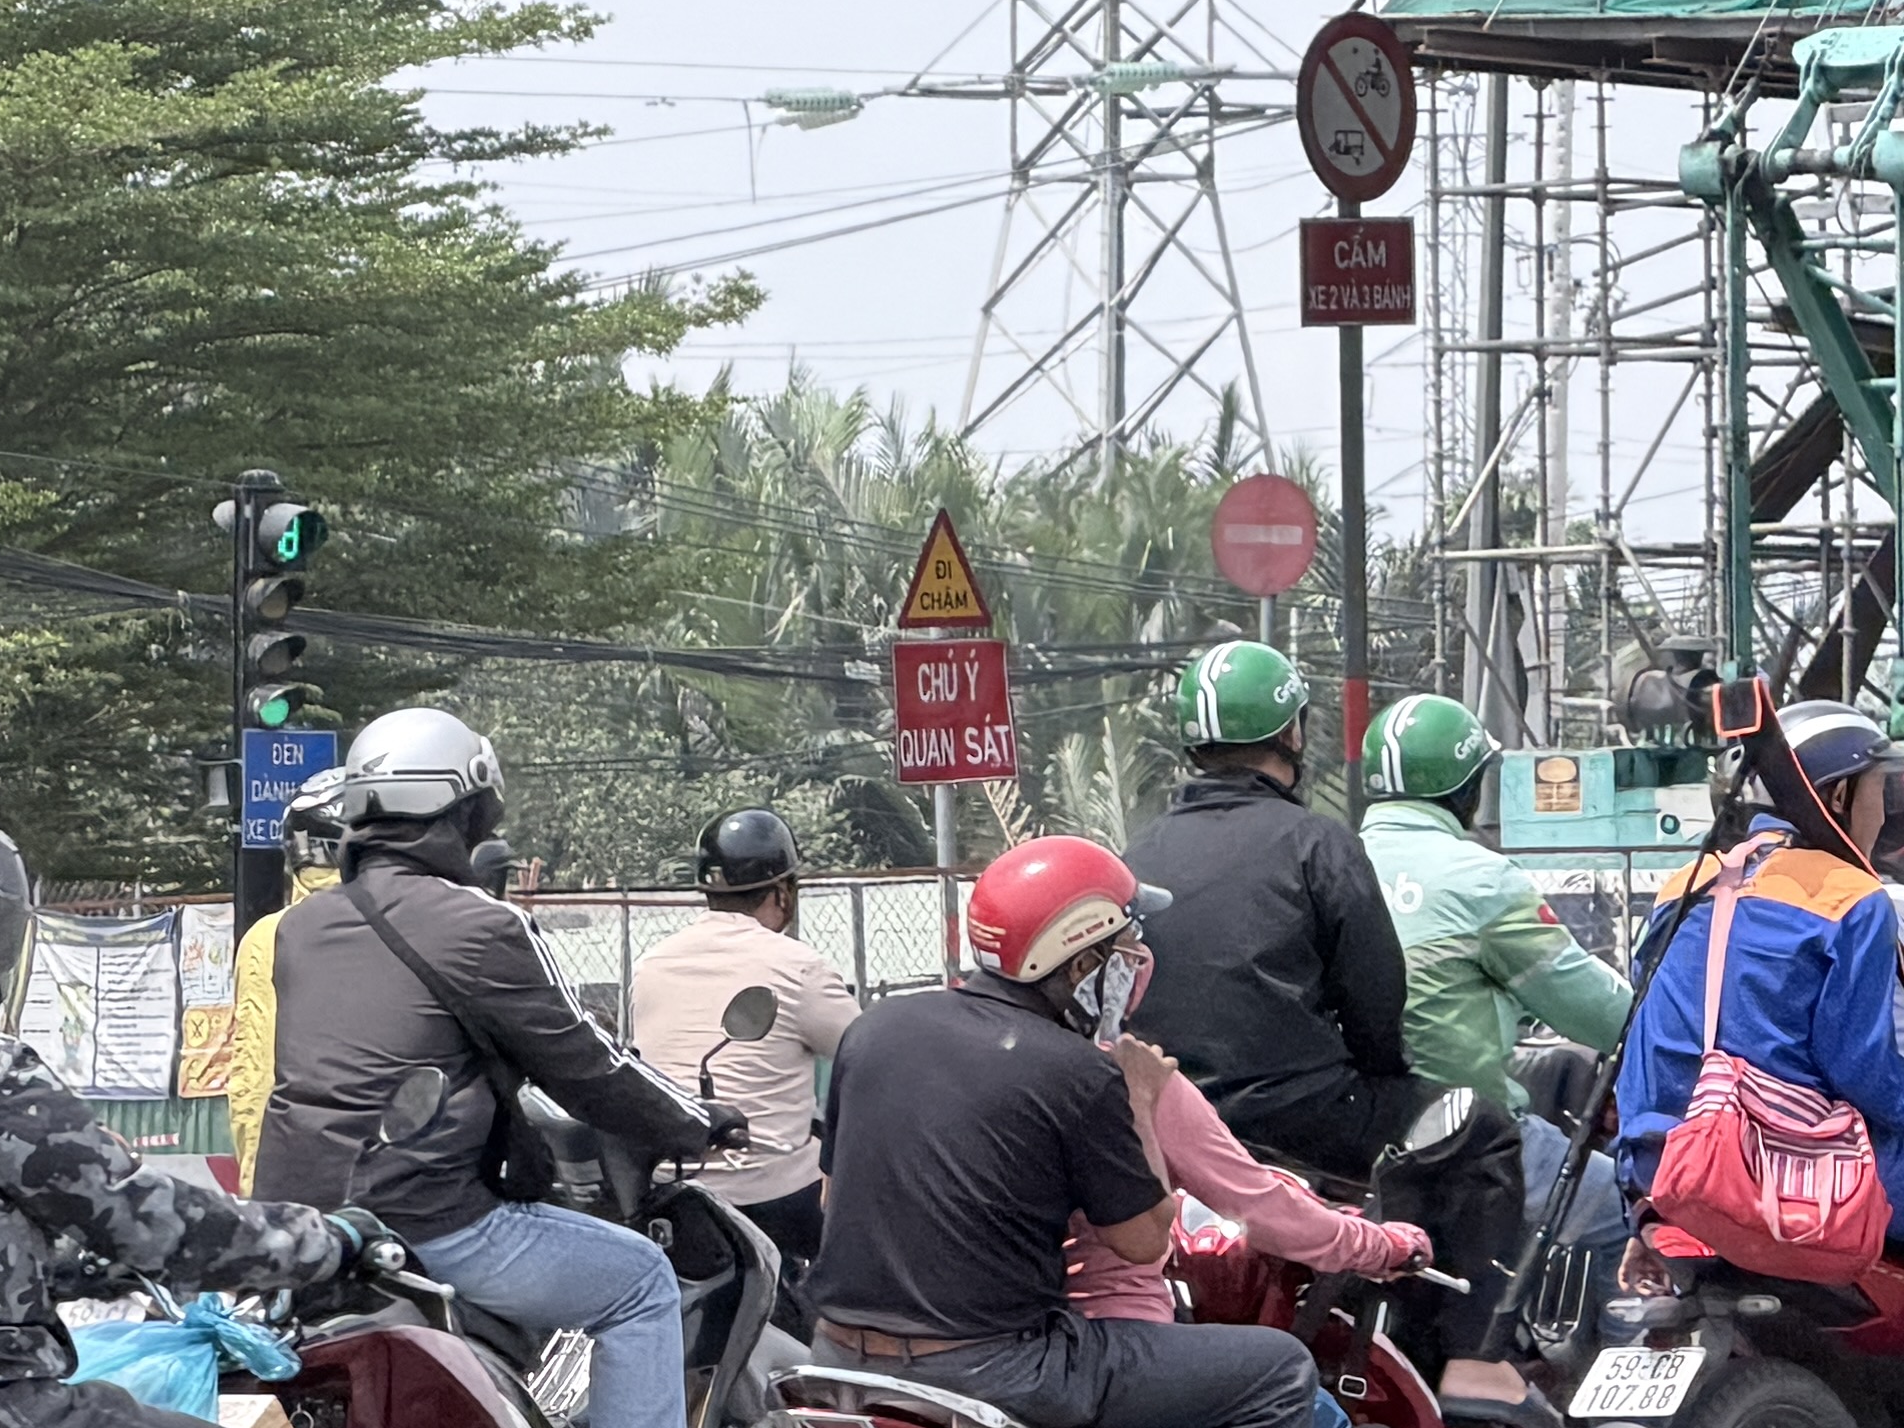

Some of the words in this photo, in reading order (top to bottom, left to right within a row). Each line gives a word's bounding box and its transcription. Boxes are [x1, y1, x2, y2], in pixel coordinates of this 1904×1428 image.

[1334, 225, 1386, 269] CẤM
[1309, 284, 1327, 310] XE
[1329, 284, 1338, 310] 2
[1340, 277, 1360, 309] VÀ
[1362, 284, 1370, 309] 3
[1373, 277, 1410, 310] BÁNH
[934, 559, 952, 580] ĐI
[920, 586, 968, 612] CHẬM
[917, 648, 958, 703] CHÚ
[965, 648, 979, 701] Ý
[900, 728, 956, 767] QUAN
[964, 713, 1010, 765] SÁT
[246, 818, 267, 841] XE
[1587, 1384, 1677, 1412] 107.88
